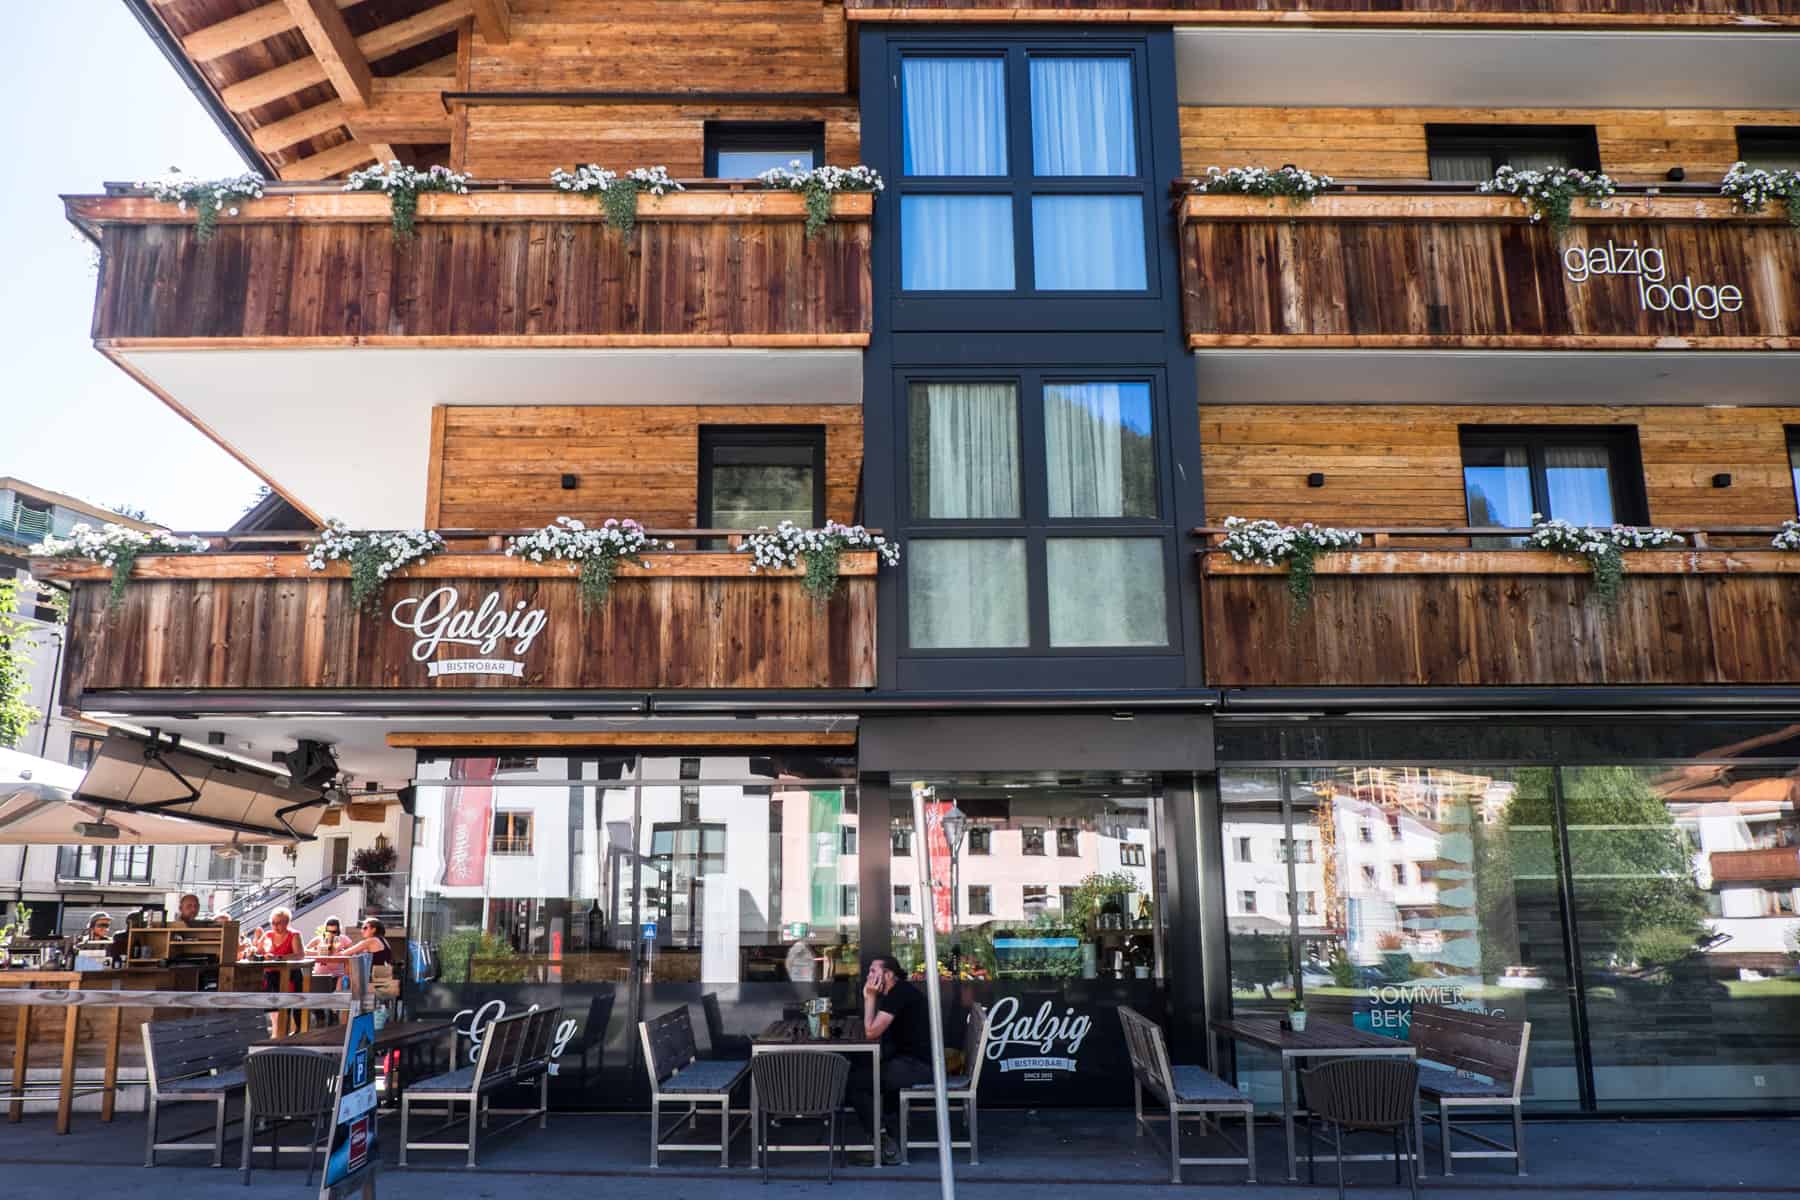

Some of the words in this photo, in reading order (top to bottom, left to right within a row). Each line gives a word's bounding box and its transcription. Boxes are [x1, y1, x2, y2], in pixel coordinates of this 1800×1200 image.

[1564, 239, 1666, 282] galzig
[1638, 276, 1743, 320] lodge
[391, 586, 548, 661] Galzig
[446, 662, 505, 672] BISTROBAR
[1368, 985, 1466, 1005] SOMMER
[983, 996, 1093, 1060] Galzig
